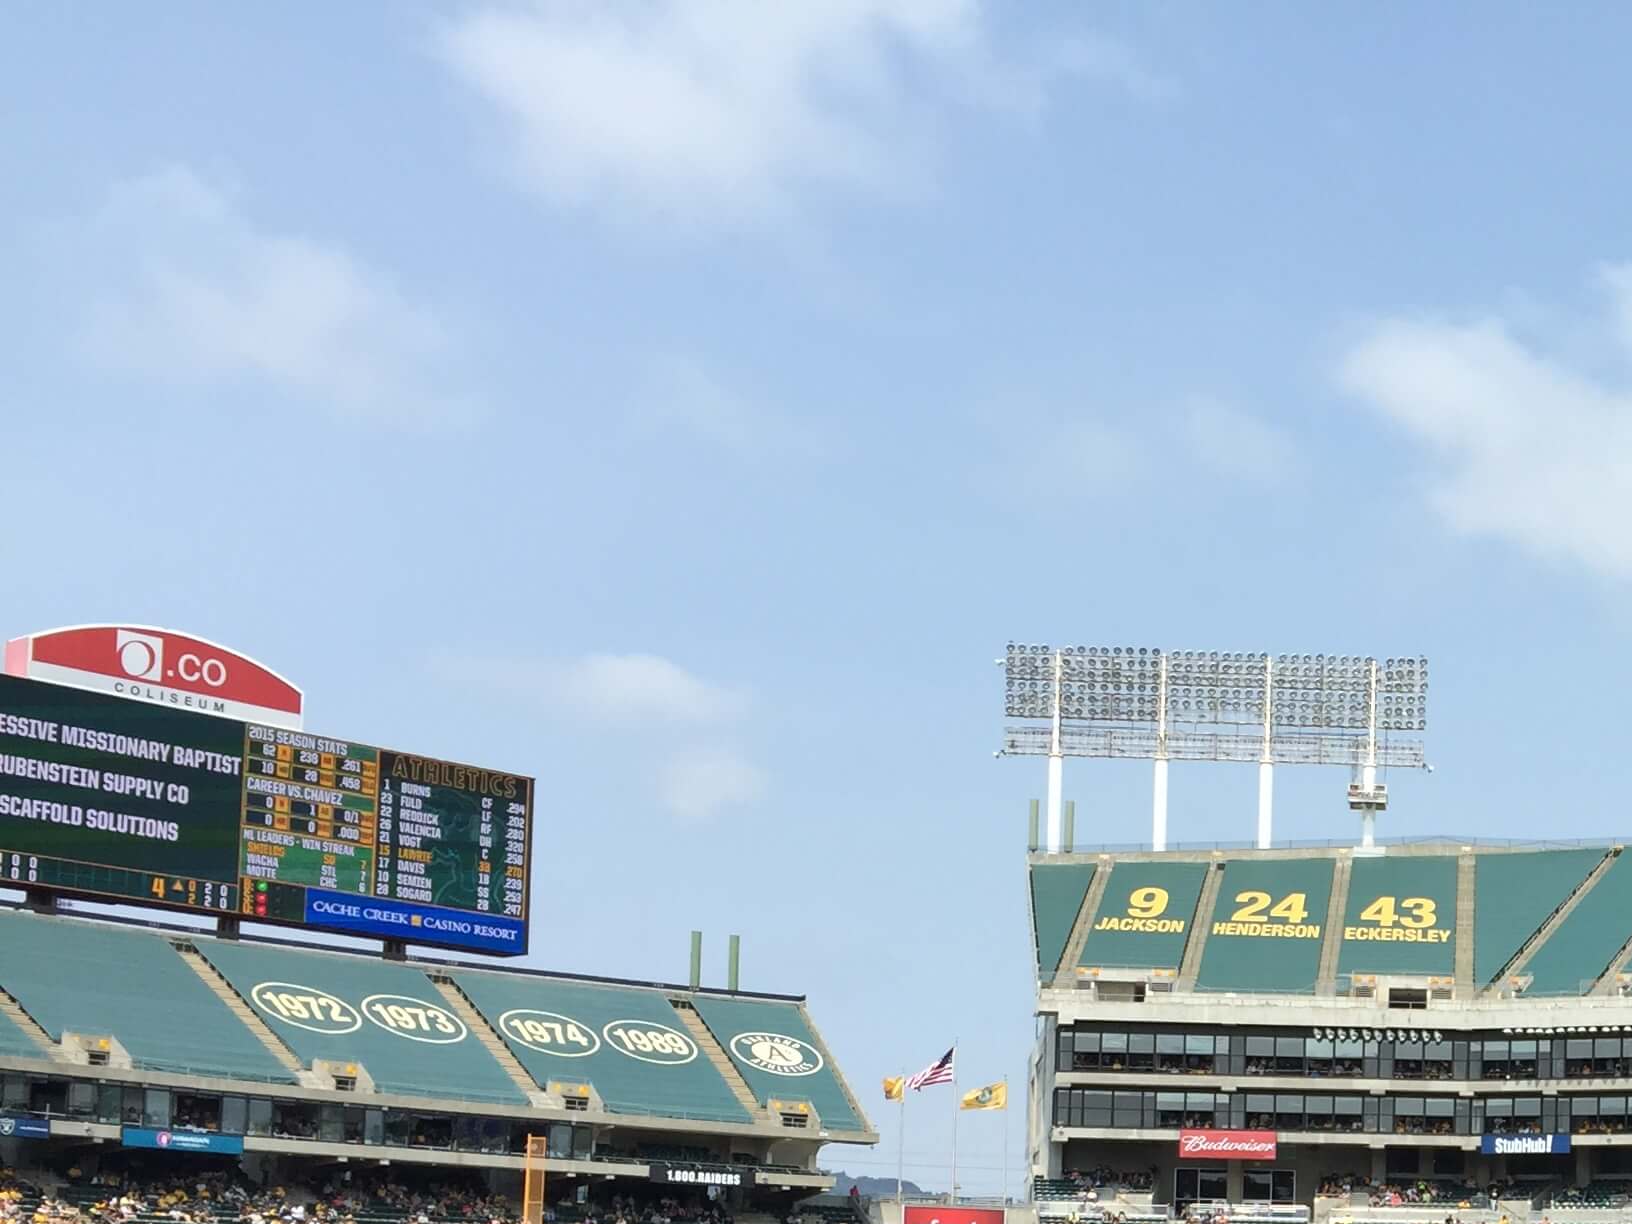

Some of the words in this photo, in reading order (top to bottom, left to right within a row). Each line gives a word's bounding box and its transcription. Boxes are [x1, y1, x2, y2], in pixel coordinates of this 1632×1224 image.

[114, 682, 225, 713] COLISEUM
[0, 713, 58, 742] ESSIVE
[61, 725, 171, 763] MISSIONARY
[173, 746, 242, 776] BAPTIST
[249, 726, 274, 741] 2015
[276, 729, 316, 750] SEASON
[317, 739, 348, 756] STATS
[103, 772, 165, 800] SUPPLY
[167, 783, 189, 805] CO
[392, 755, 517, 799] ATHLETICS
[247, 777, 286, 794] CAREER
[304, 788, 343, 805] CHAVEZ
[400, 796, 422, 809] FULD
[401, 782, 431, 797] BURNS
[481, 797, 493, 809] CF
[0, 794, 82, 826] SCAFFOLD
[86, 808, 179, 841] SOLUTIONS
[399, 808, 440, 826] REDDICK
[399, 821, 441, 839] VALENCIA
[256, 831, 295, 846] LEADERS
[398, 834, 422, 848] VOGT
[247, 853, 279, 868] WACHA
[397, 860, 425, 875] DAVIS
[11, 854, 20, 867] 0
[29, 857, 37, 869] 0
[152, 878, 165, 898] 4
[204, 882, 213, 894] 2
[11, 867, 20, 880] 0
[28, 870, 37, 882] 0
[203, 894, 213, 907] 2
[397, 872, 432, 889] SEMIEN
[396, 886, 432, 902] SOGARD
[1128, 887, 1169, 918] 9
[1231, 891, 1308, 924] 24
[313, 900, 361, 918] CACHE
[363, 907, 408, 925] CREEK
[423, 917, 471, 934] CASINO
[474, 924, 518, 940] RESORT
[1095, 916, 1185, 933] JACKSON
[1360, 897, 1437, 928] 43
[1212, 922, 1320, 939] HENDERSON
[1344, 926, 1451, 943] ECKERSLEY
[262, 991, 352, 1023] 1972
[371, 1003, 455, 1034] 1973
[509, 1019, 589, 1046] 1974
[612, 1028, 690, 1055] 1989
[750, 1058, 814, 1073] ATHLETICS
[1183, 1135, 1275, 1152] Budweiser
[1495, 1135, 1553, 1153] StubHub!
